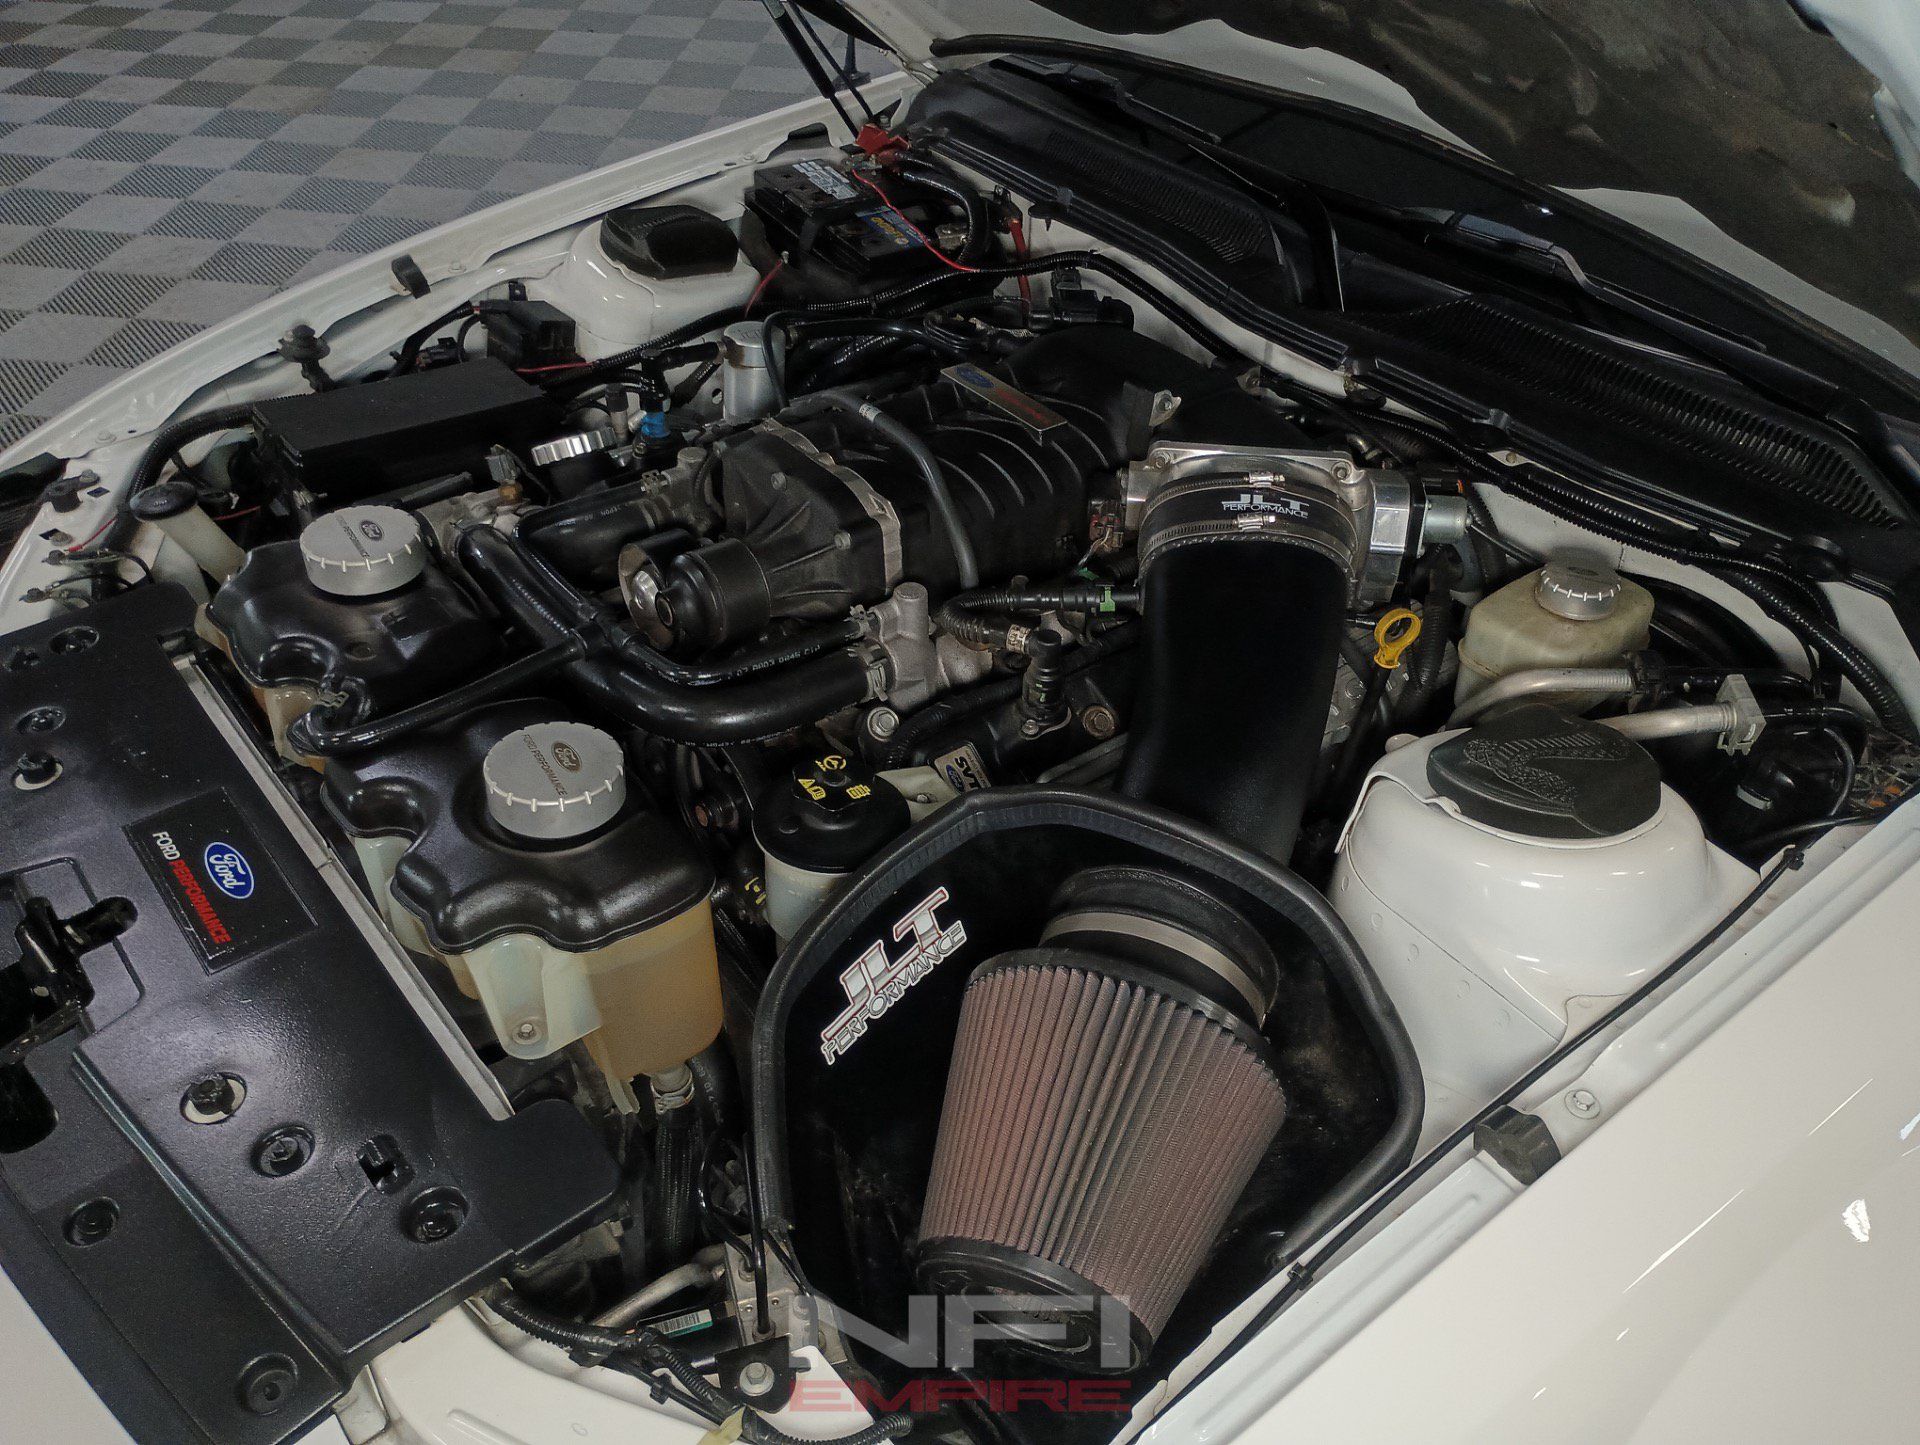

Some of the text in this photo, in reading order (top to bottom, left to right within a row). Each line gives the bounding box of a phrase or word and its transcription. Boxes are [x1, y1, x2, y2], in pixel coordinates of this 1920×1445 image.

[1222, 494, 1309, 510] JLT
[1223, 504, 1308, 518] PERFORMANCE
[953, 755, 981, 788] SVT
[152, 831, 231, 943] FORD PERFORMANCE
[209, 853, 245, 889] Ford
[821, 886, 949, 1041] JLT
[821, 920, 967, 1065] PERFORMANCE
